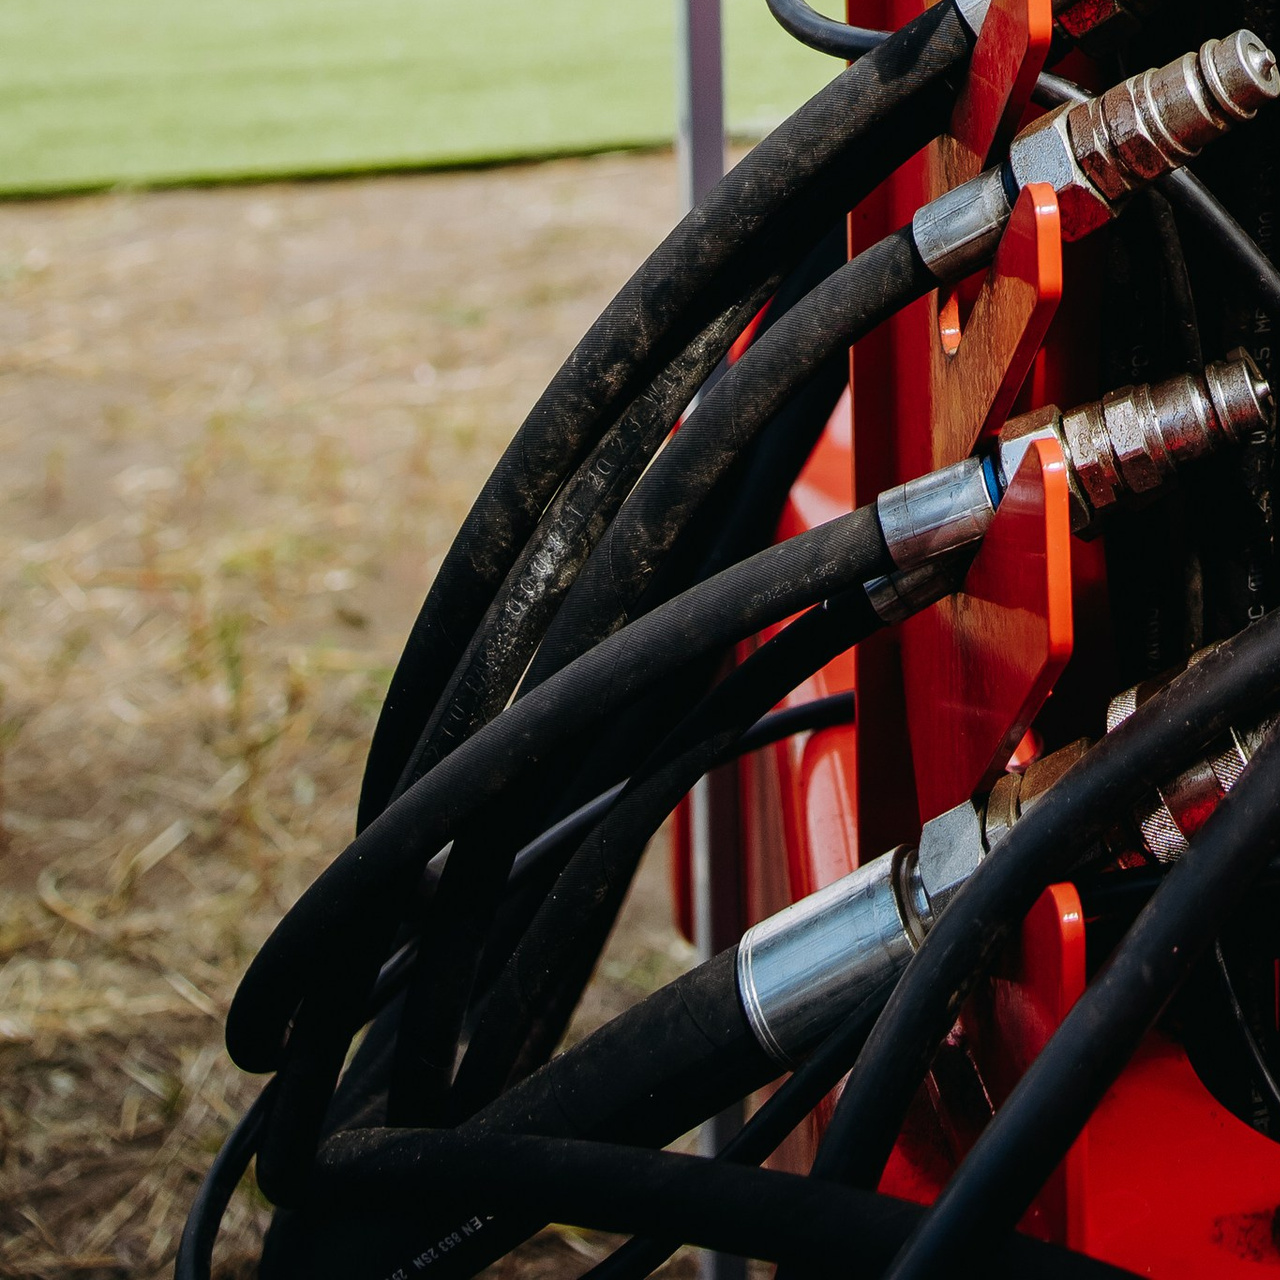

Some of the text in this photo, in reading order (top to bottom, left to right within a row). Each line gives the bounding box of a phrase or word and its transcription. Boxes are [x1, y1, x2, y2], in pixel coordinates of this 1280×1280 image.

[461, 1216, 483, 1236] EN
[438, 1231, 462, 1252] 853
[412, 1247, 438, 1270] 2SN
